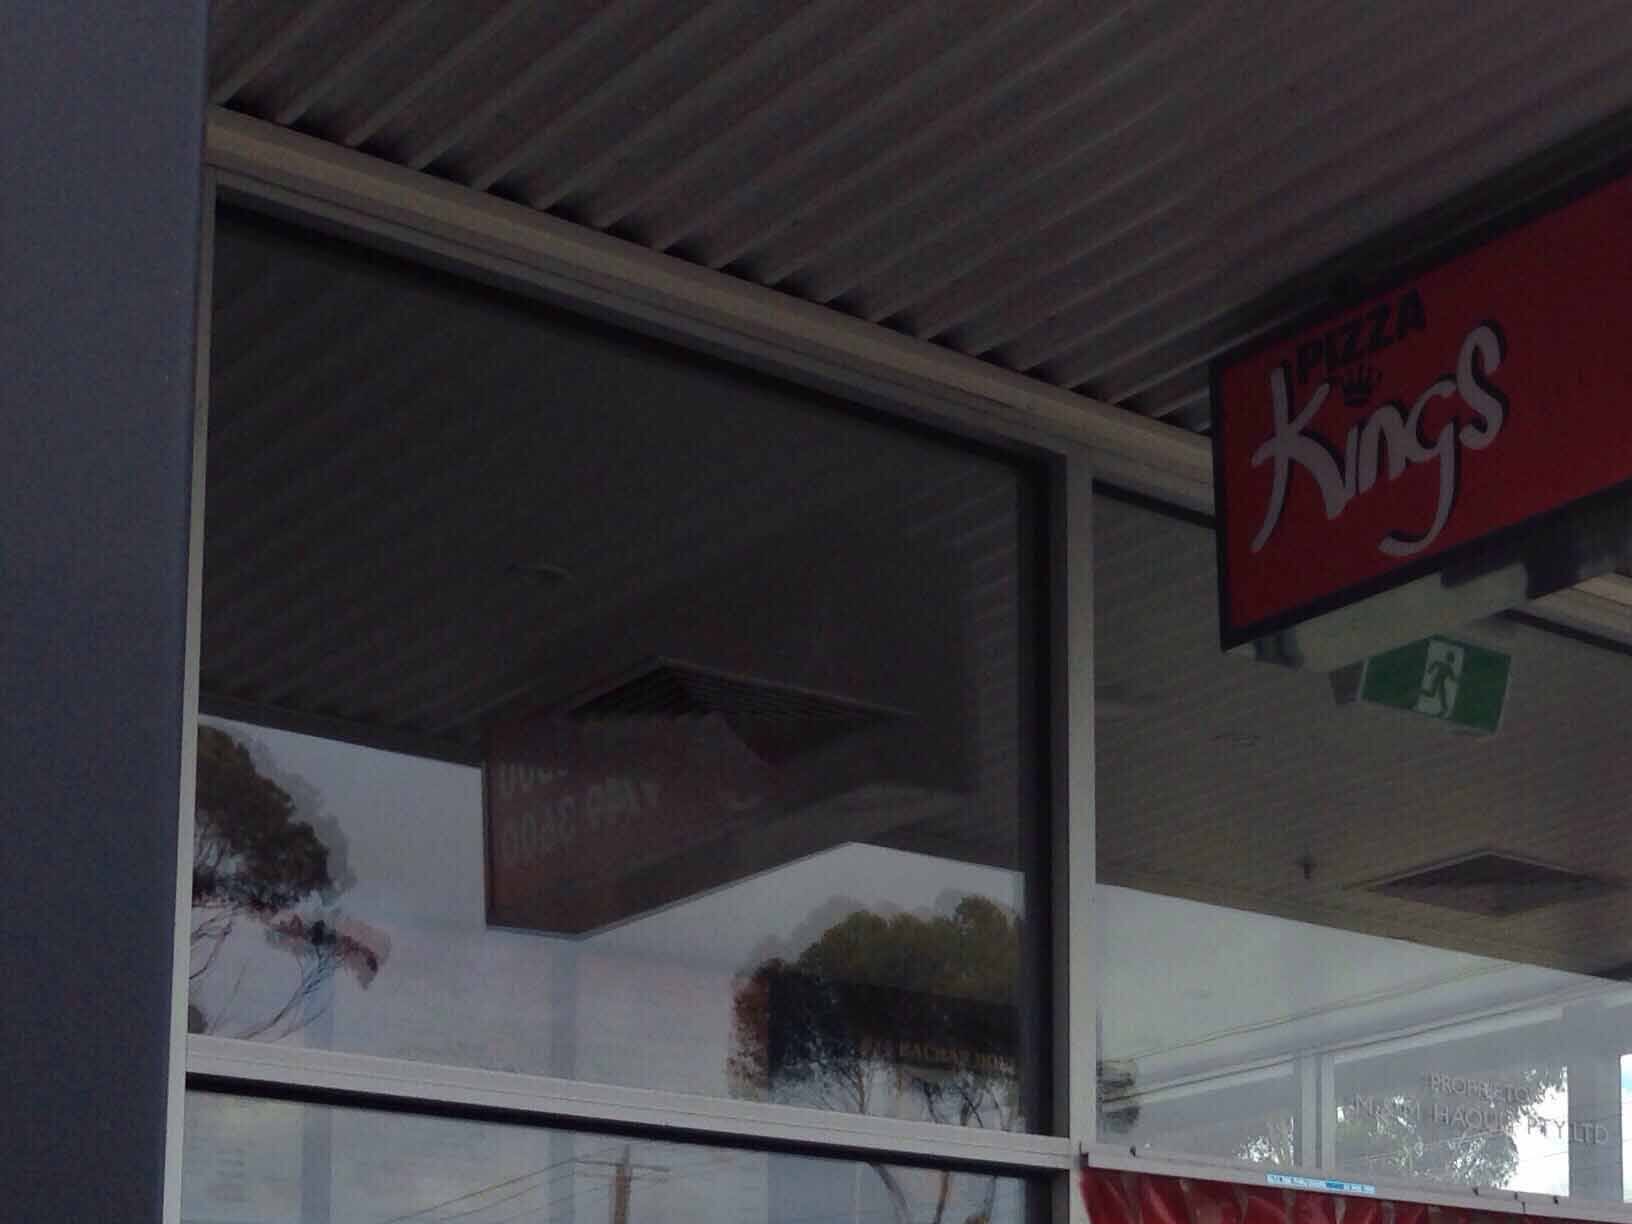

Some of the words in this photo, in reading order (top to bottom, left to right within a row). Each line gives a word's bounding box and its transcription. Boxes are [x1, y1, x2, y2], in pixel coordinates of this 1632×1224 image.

[1295, 288, 1425, 387] PIZZA
[1250, 318, 1509, 557] Kings
[1569, 1121, 1609, 1145] LTD
